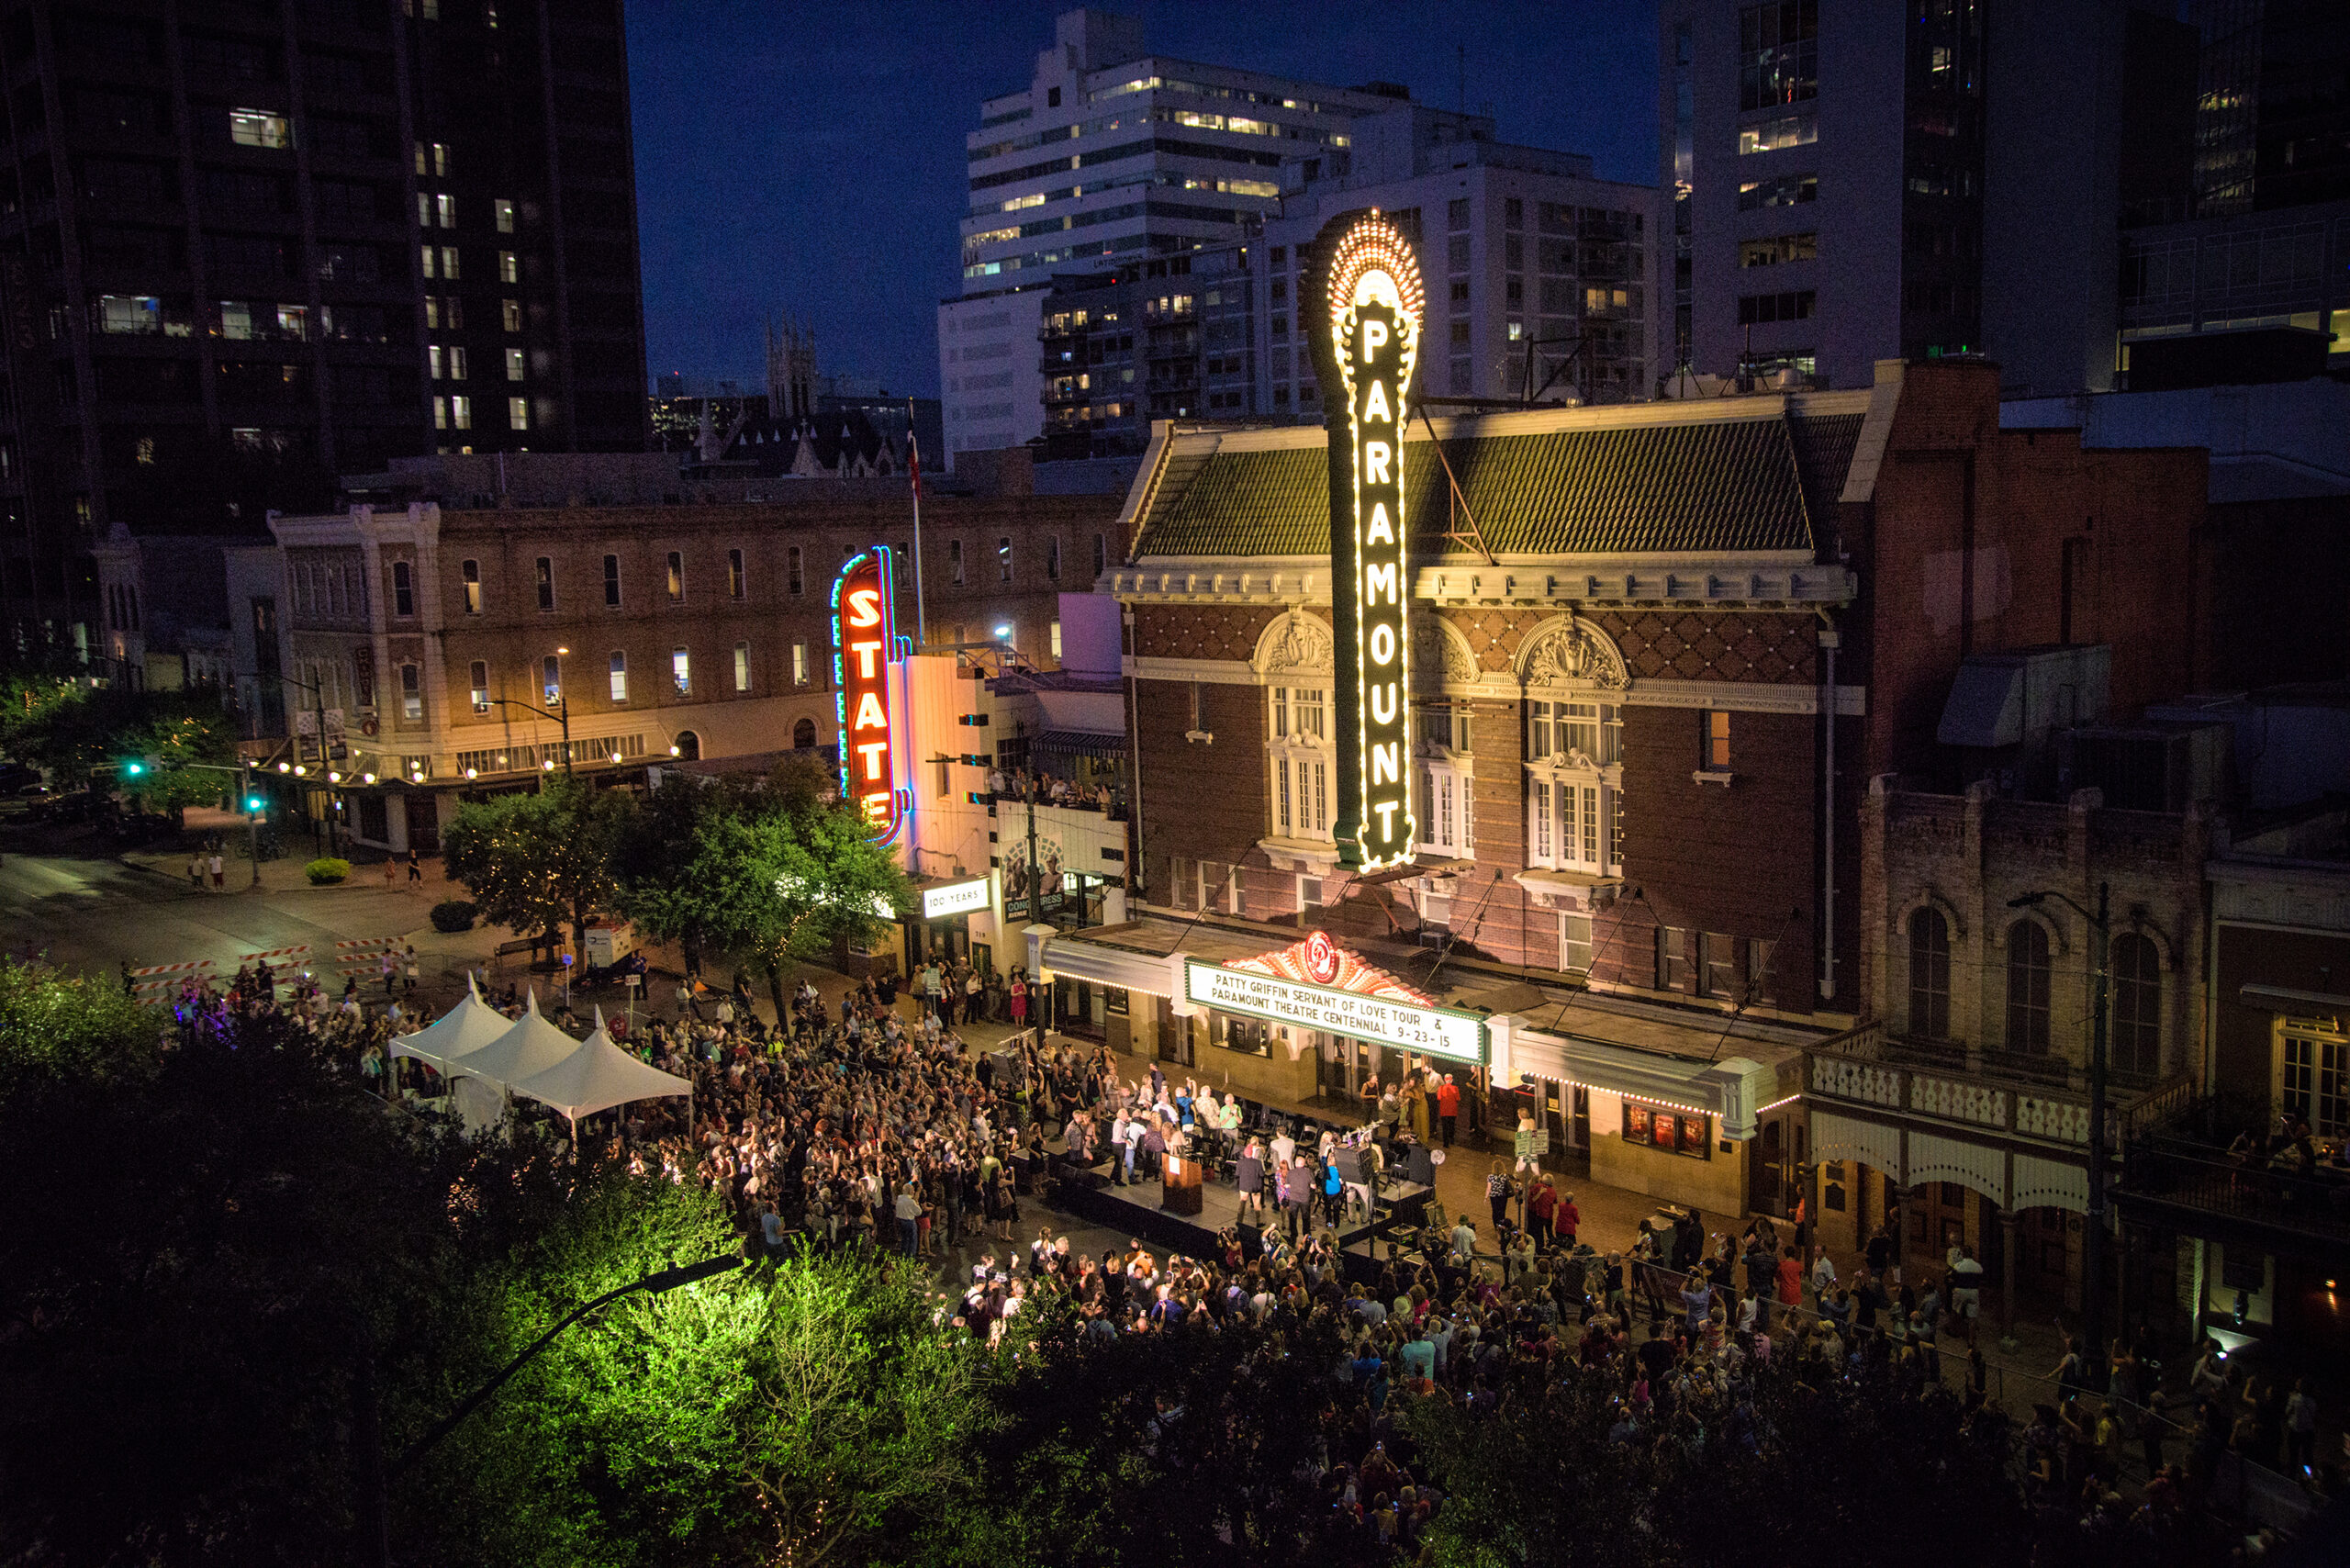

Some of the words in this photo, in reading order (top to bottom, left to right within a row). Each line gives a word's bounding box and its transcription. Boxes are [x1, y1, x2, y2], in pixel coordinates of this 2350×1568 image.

[1362, 319, 1400, 843] PARAMOUNT
[848, 589, 890, 828] STATE
[929, 896, 946, 908] 100
[950, 890, 979, 902] YEARS
[1212, 988, 1270, 1009] PARAMOUNT
[1274, 1000, 1318, 1020] THEATRE
[1323, 1011, 1388, 1035] CENTENNIAL
[1215, 974, 1247, 990] PATTY
[1249, 981, 1288, 999] GRIFFIN
[1292, 990, 1337, 1009] SERVANT
[1341, 1000, 1355, 1012] OF
[1360, 1003, 1387, 1019] LOVE
[1392, 1009, 1420, 1026] TOUR
[1434, 1018, 1442, 1030] &
